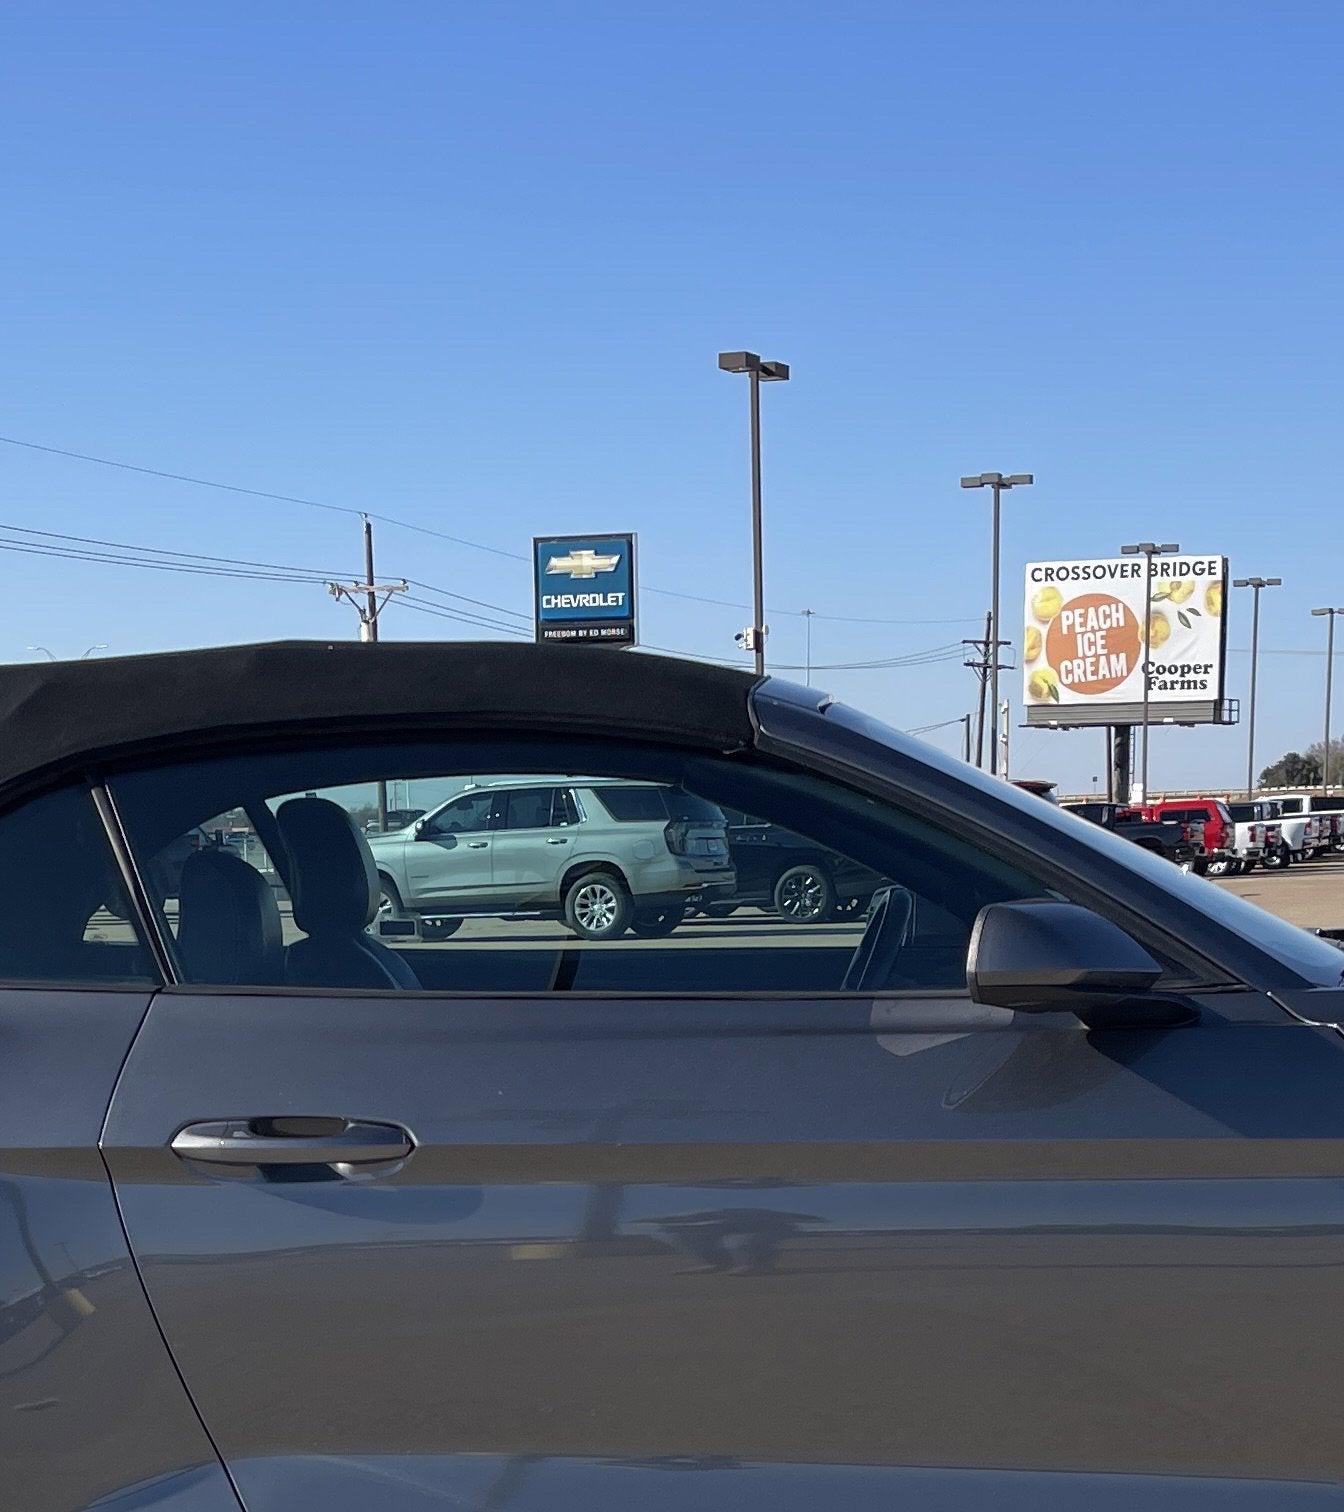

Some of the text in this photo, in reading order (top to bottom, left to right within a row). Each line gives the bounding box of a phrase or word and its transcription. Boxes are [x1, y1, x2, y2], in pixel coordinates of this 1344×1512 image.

[1031, 560, 1217, 582] CROSSOVER BRIDGE
[542, 592, 625, 609] CHEVROLET
[1061, 603, 1125, 635] PEACH
[544, 629, 576, 638] FREEDOM
[1076, 630, 1108, 658] ICE
[1059, 652, 1128, 685] CREAM
[1141, 661, 1213, 678] Cooper
[1146, 676, 1207, 691] Farms
